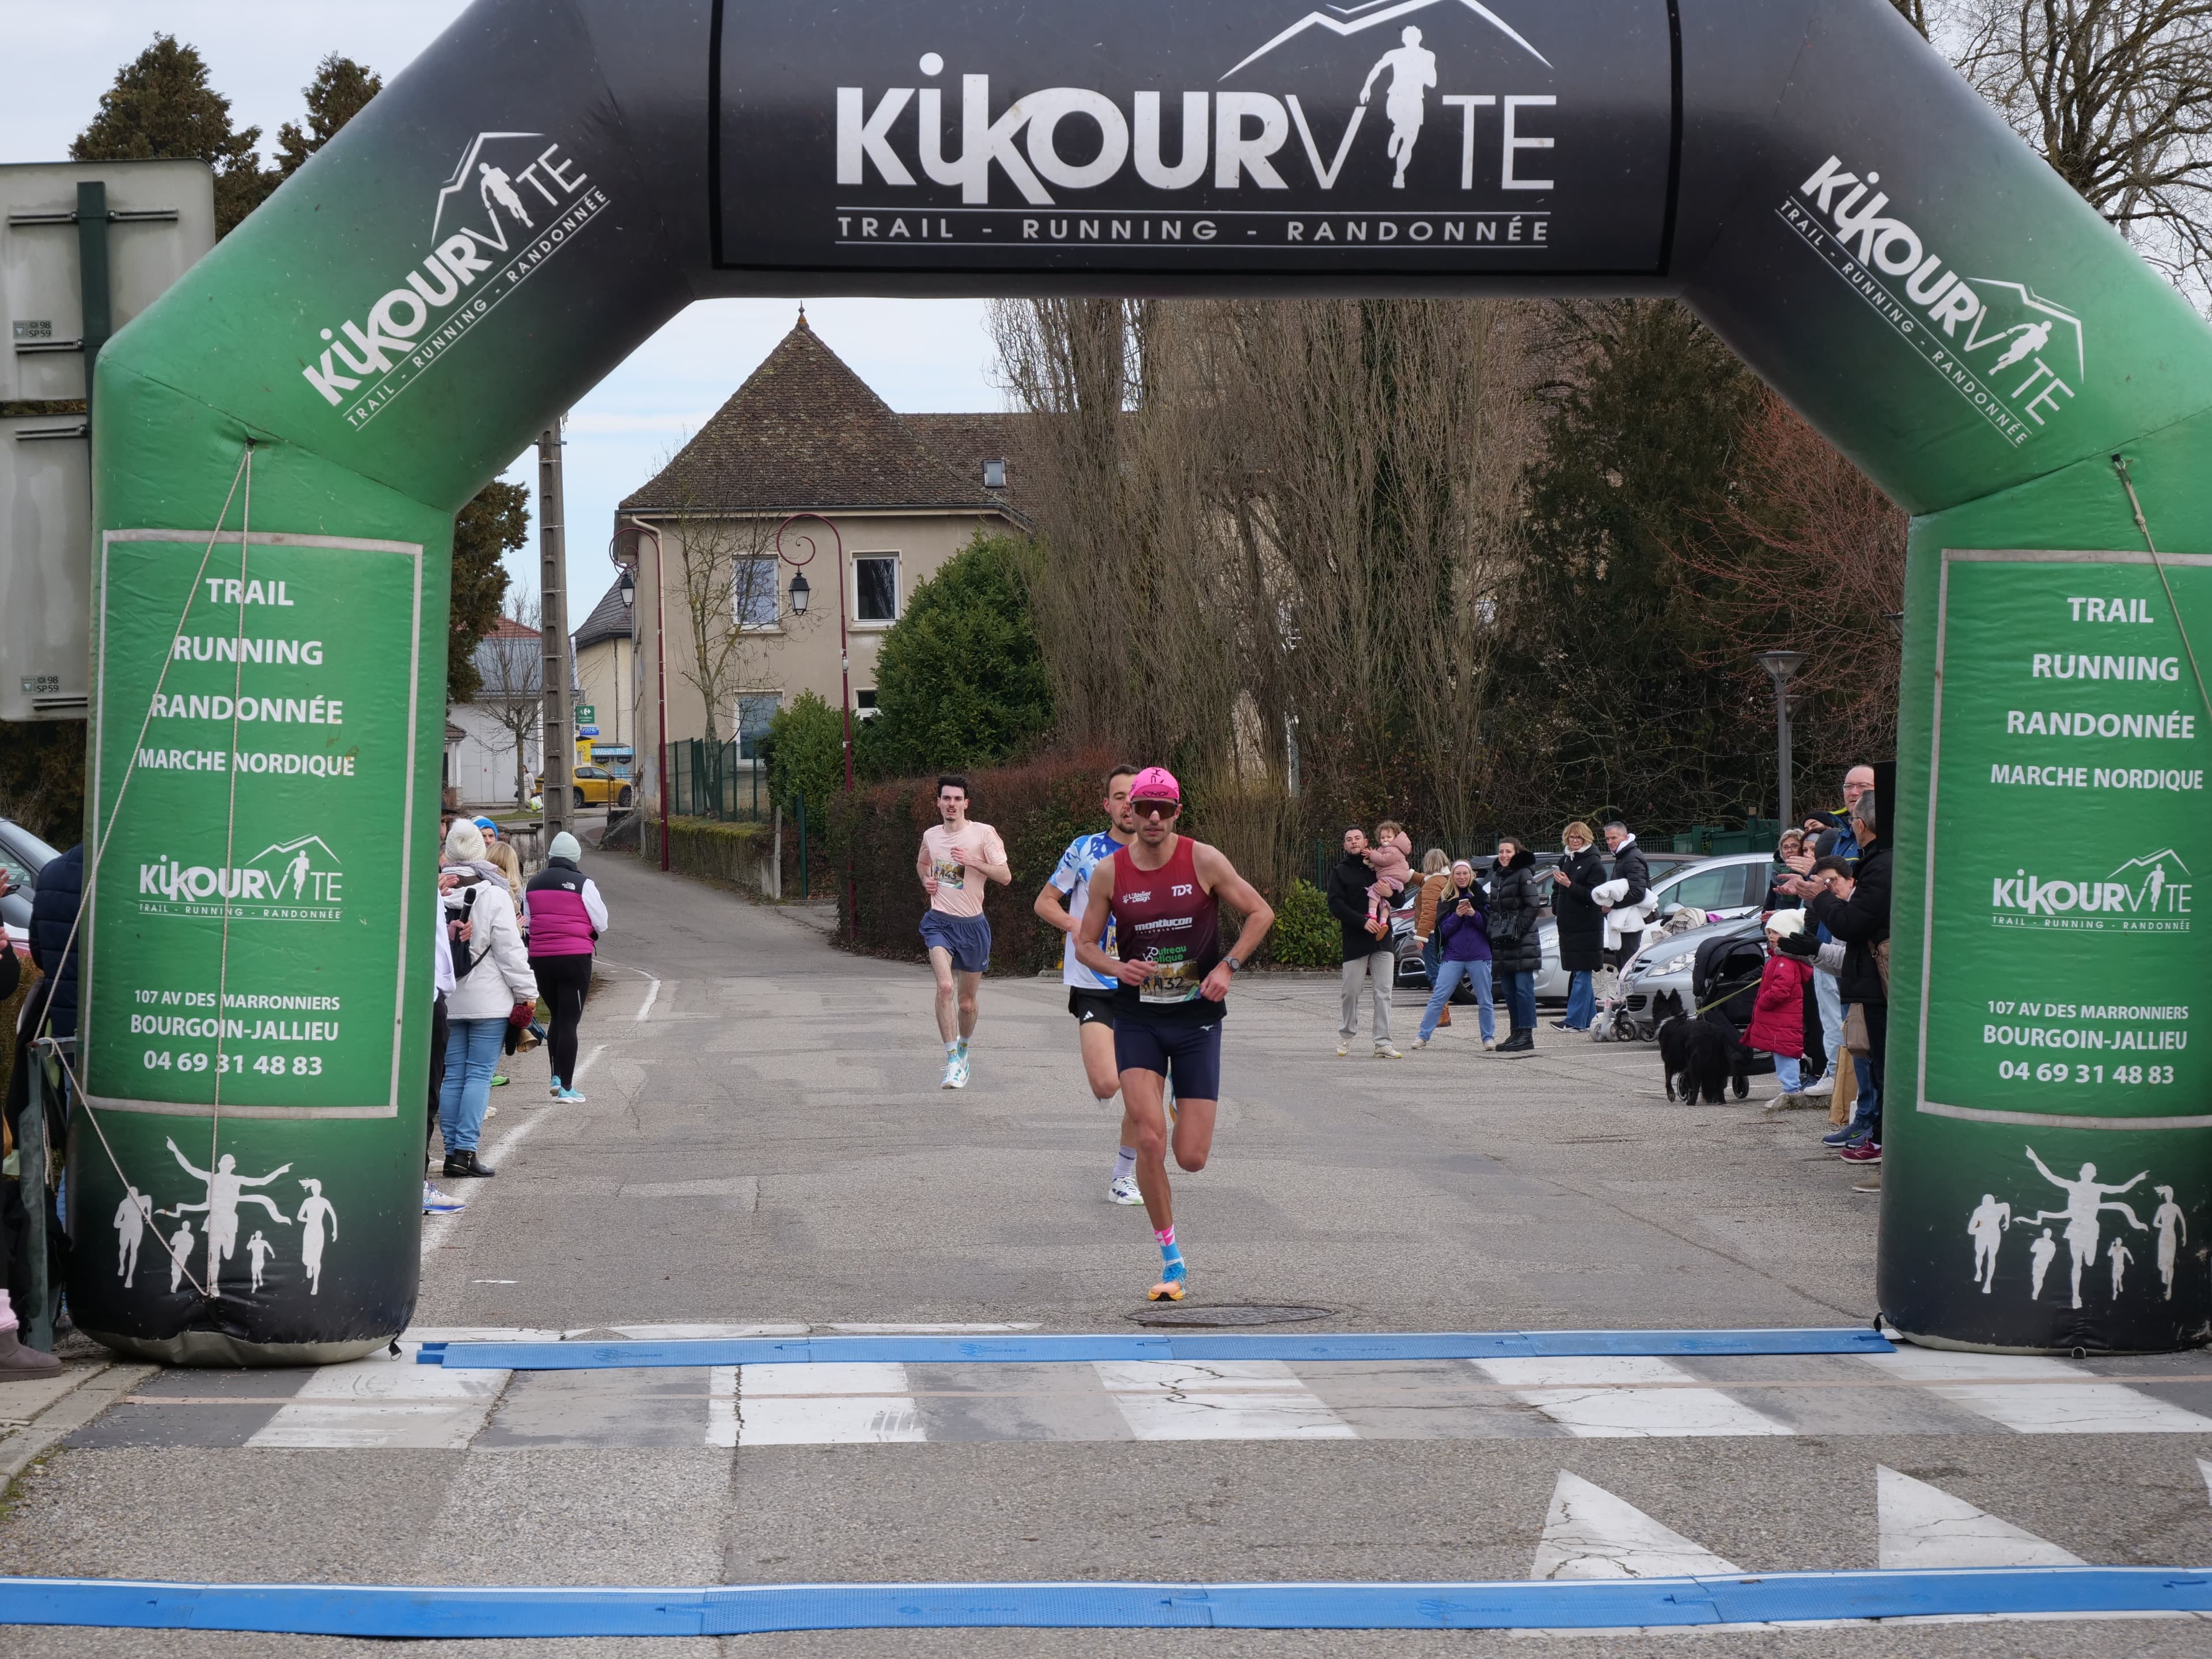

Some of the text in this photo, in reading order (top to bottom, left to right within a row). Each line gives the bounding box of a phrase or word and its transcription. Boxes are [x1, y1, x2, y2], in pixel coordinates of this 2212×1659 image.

[837, 216, 953, 239] TRAIL
[1022, 218, 1218, 242] RUNNING
[1287, 215, 1548, 243] RANDONNÉE
[347, 386, 393, 426] TRAIL
[412, 300, 487, 368] RUNNING
[506, 190, 608, 283] RANDONNÉE
[1781, 200, 1824, 248] TRAIL
[1842, 262, 1915, 334] RUNNING
[1931, 351, 2029, 444] RANDONNÉE
[206, 578, 294, 606] TRAIL
[2067, 597, 2154, 623] TRAIL
[173, 636, 323, 665] RUNNING
[2032, 654, 2179, 681] RUNNING
[150, 693, 343, 724] RANDONNÉE
[2008, 711, 2195, 738] RANDONNÉE
[138, 749, 355, 778] MARCHE NORDIQUE
[1991, 764, 2203, 791] MARCHE NORDIQUE
[1171, 884, 1192, 896] TDR
[139, 904, 168, 914] TRAIL
[185, 906, 243, 916] RUNNING
[263, 907, 340, 919] RANDONNÉE
[1993, 916, 2025, 926] TRAIL
[2044, 918, 2104, 929] RUNNING
[2123, 920, 2190, 930] RANDONNÉE
[135, 990, 340, 1010] 107 AV DES MARRONNIERS
[1988, 1001, 2189, 1020] 107 AV DES MARRONNIERS
[131, 1014, 339, 1040] BOURGOIN-JALLIEU
[1983, 1025, 2187, 1050] BOURGOIN-JALLIEU
[143, 1050, 322, 1075] 04 69 31 48 83
[1999, 1060, 2175, 1085] 04 69 31 48 83
